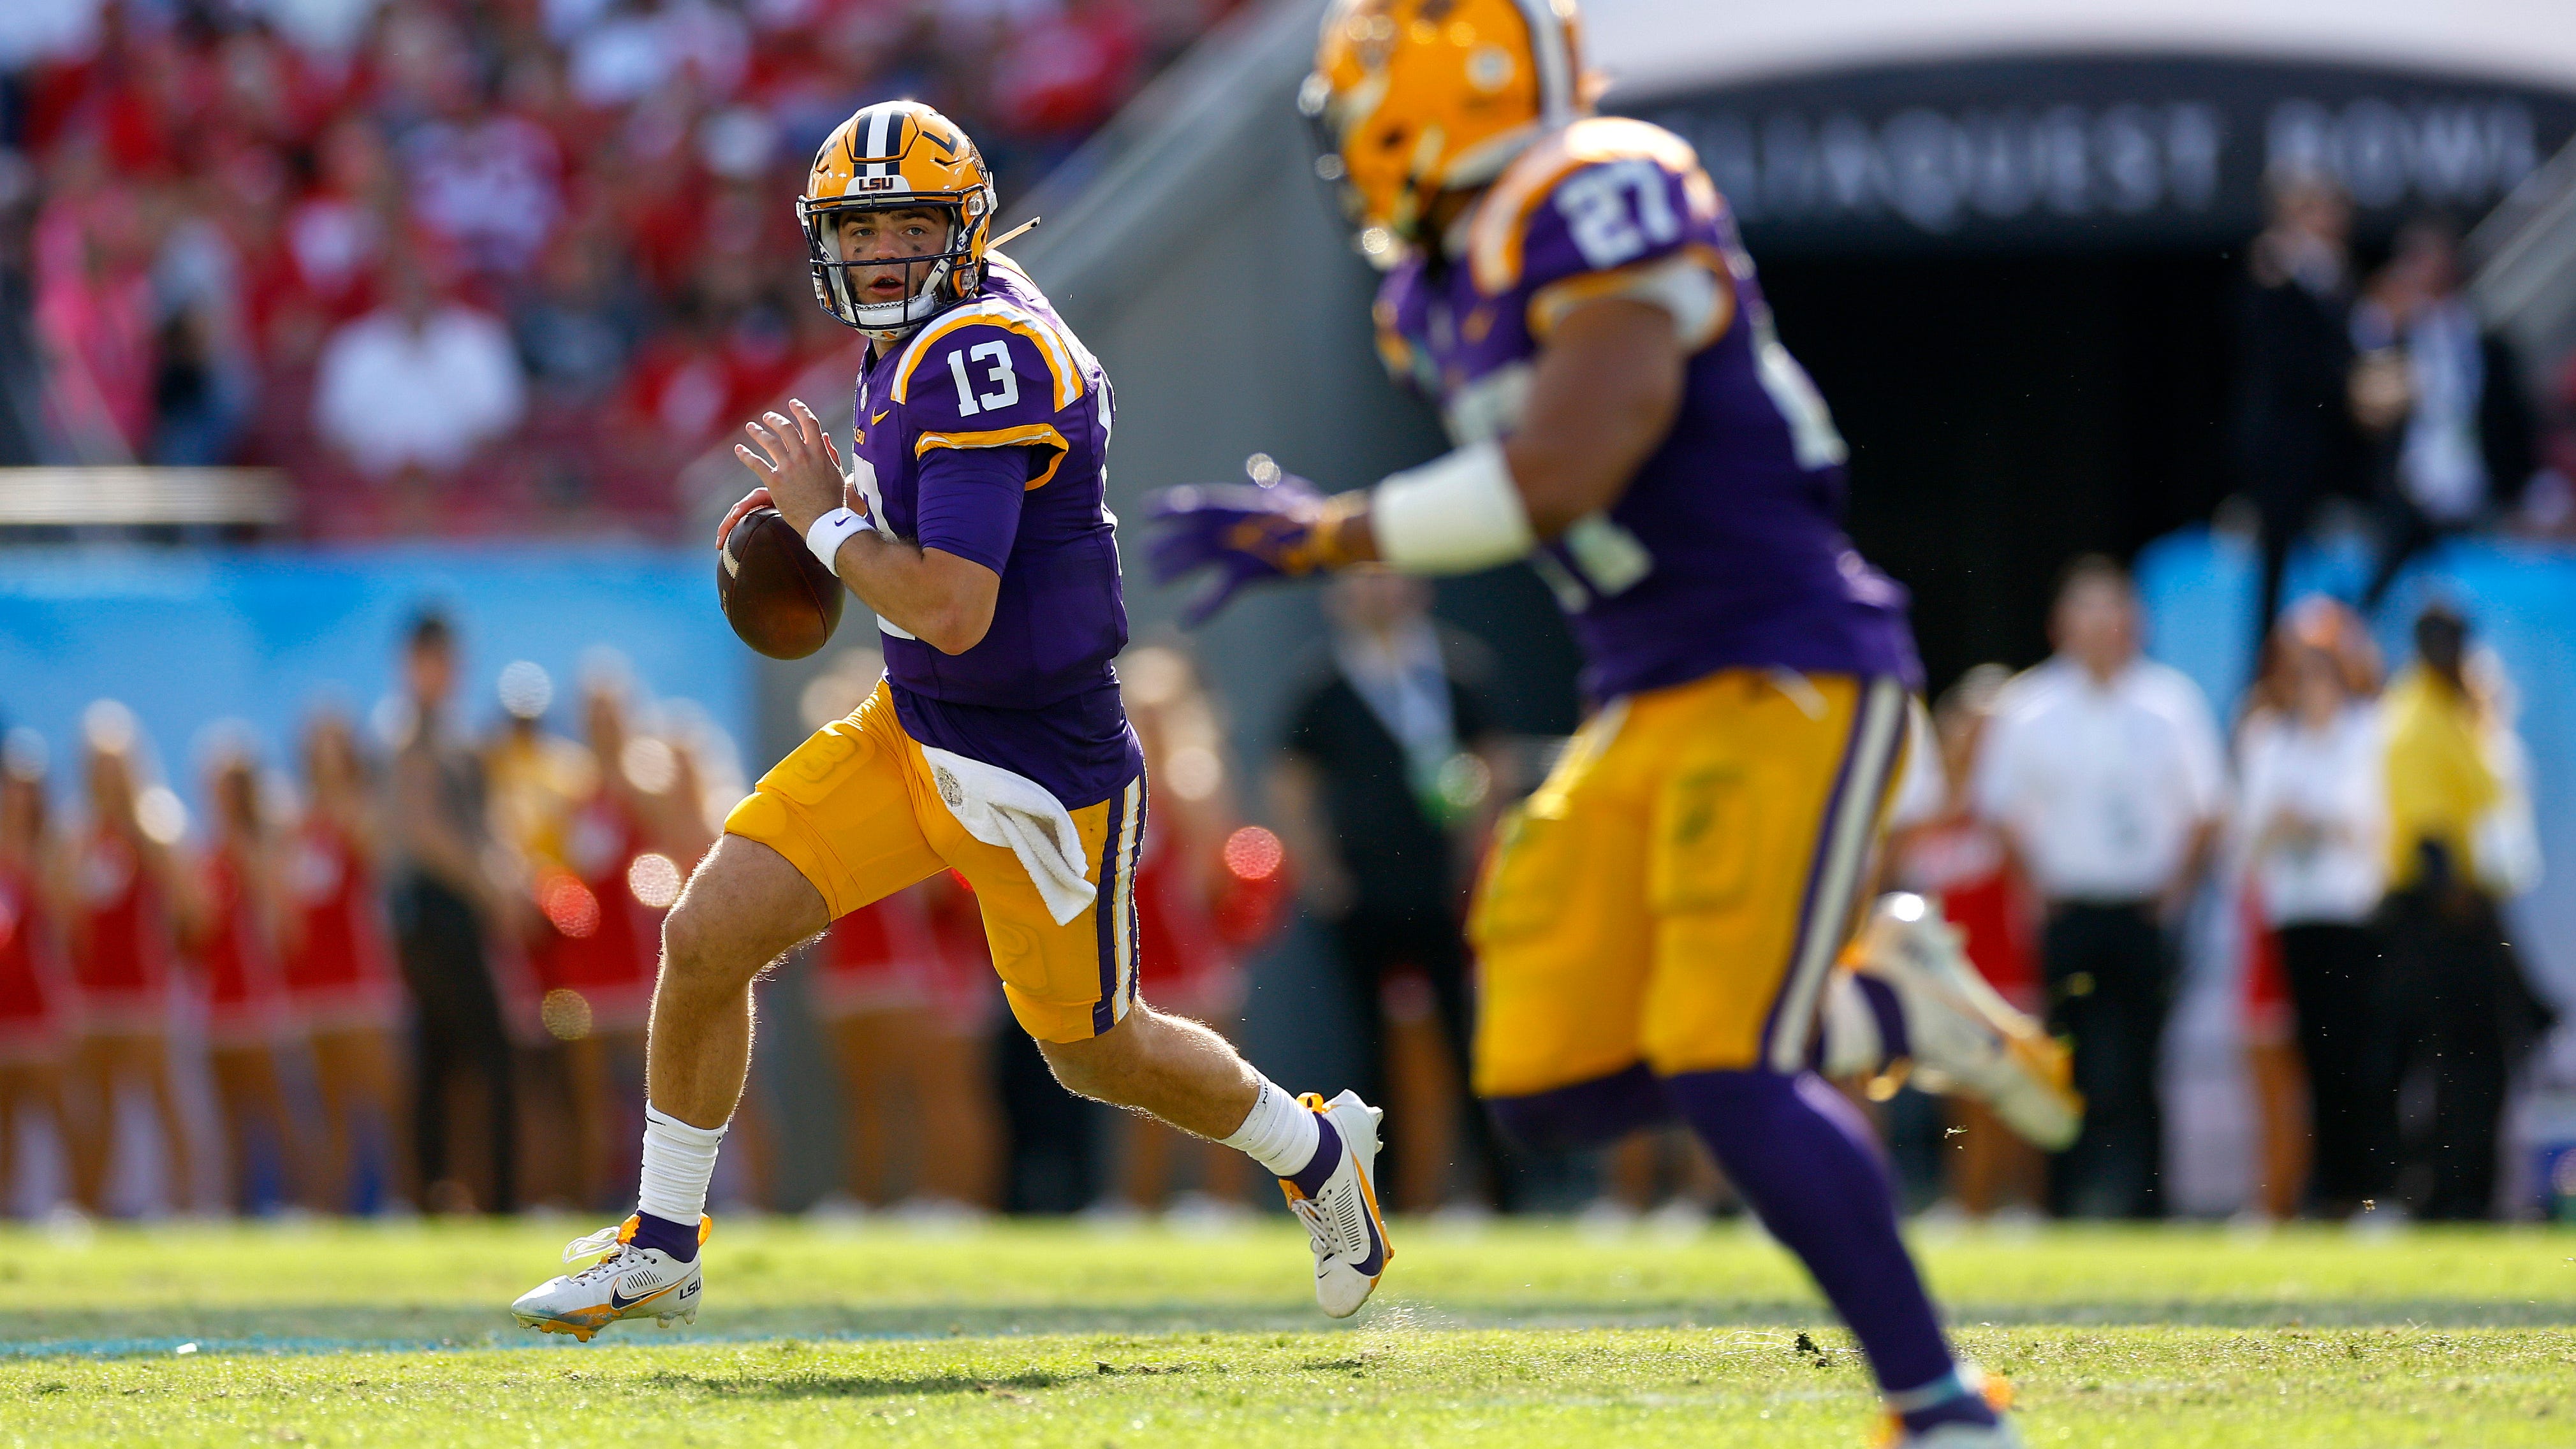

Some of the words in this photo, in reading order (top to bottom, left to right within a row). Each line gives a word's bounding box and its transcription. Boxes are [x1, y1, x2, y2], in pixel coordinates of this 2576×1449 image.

[859, 177, 894, 192] LSU
[1555, 159, 1682, 268] 27
[948, 340, 1019, 418] 13
[679, 1276, 701, 1300] LSU
